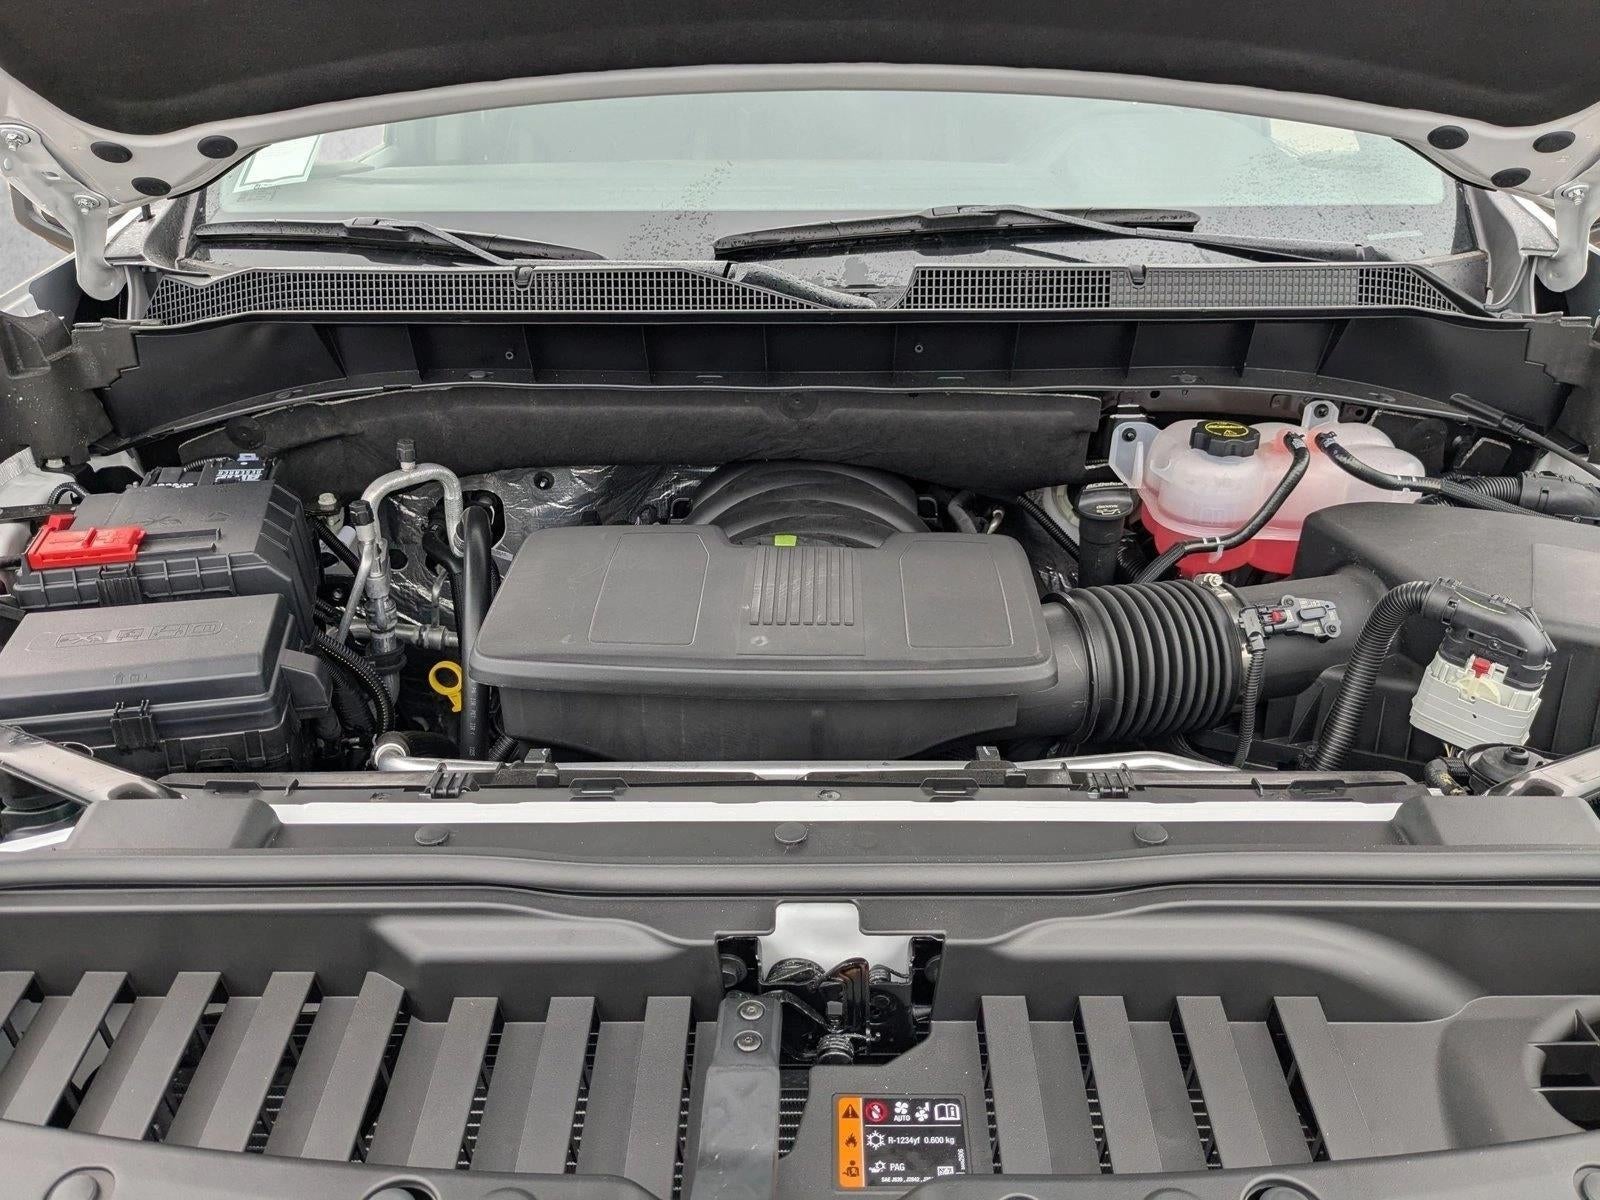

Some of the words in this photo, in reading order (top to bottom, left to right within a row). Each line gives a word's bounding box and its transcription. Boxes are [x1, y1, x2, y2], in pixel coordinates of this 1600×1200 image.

[887, 1136, 920, 1145] R-1234yf
[924, 1136, 944, 1144] 0.600
[945, 1136, 955, 1144] kg
[890, 1163, 906, 1171] PAG
